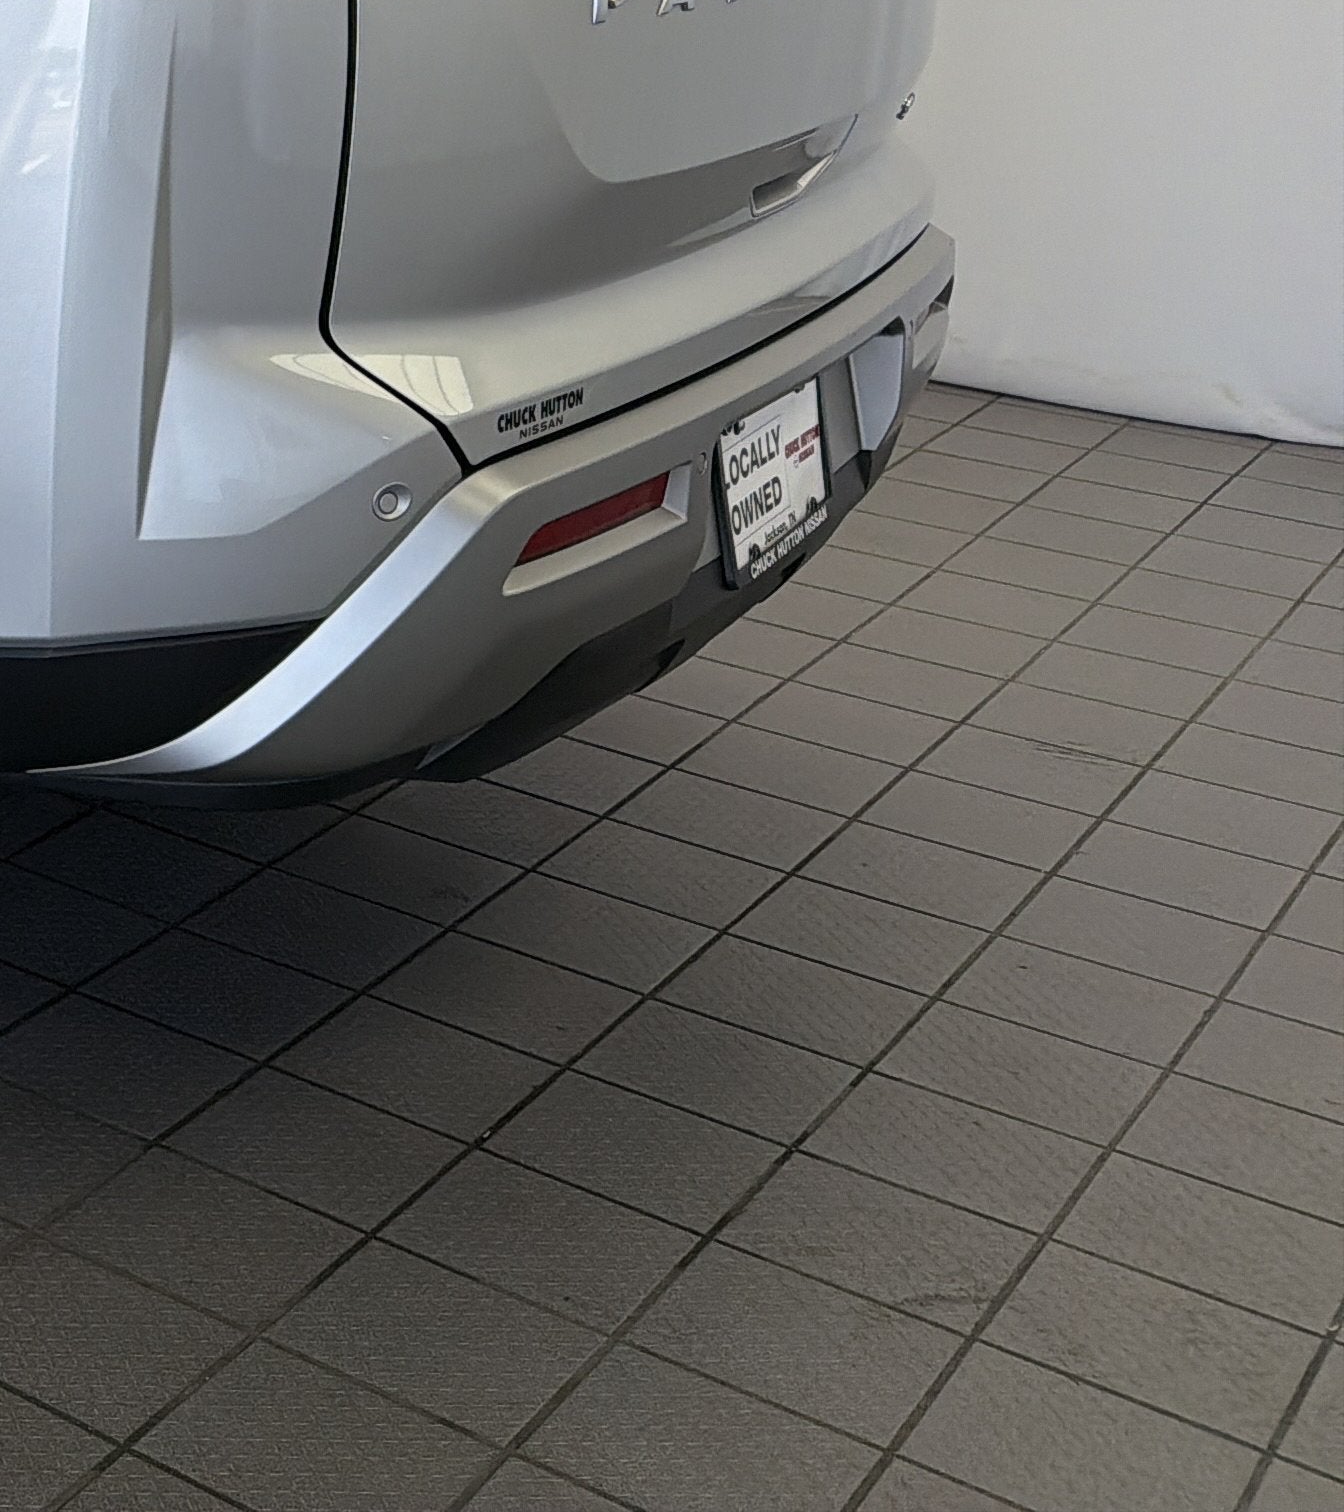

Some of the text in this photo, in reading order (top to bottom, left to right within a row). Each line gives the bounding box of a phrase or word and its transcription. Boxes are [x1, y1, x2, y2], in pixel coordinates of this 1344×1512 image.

[497, 387, 584, 433] CHUCK HUTTON
[519, 415, 564, 439] NISSAN
[732, 476, 783, 535] OWNED
[751, 504, 828, 580] CHUCK HUTTON NISSAN
